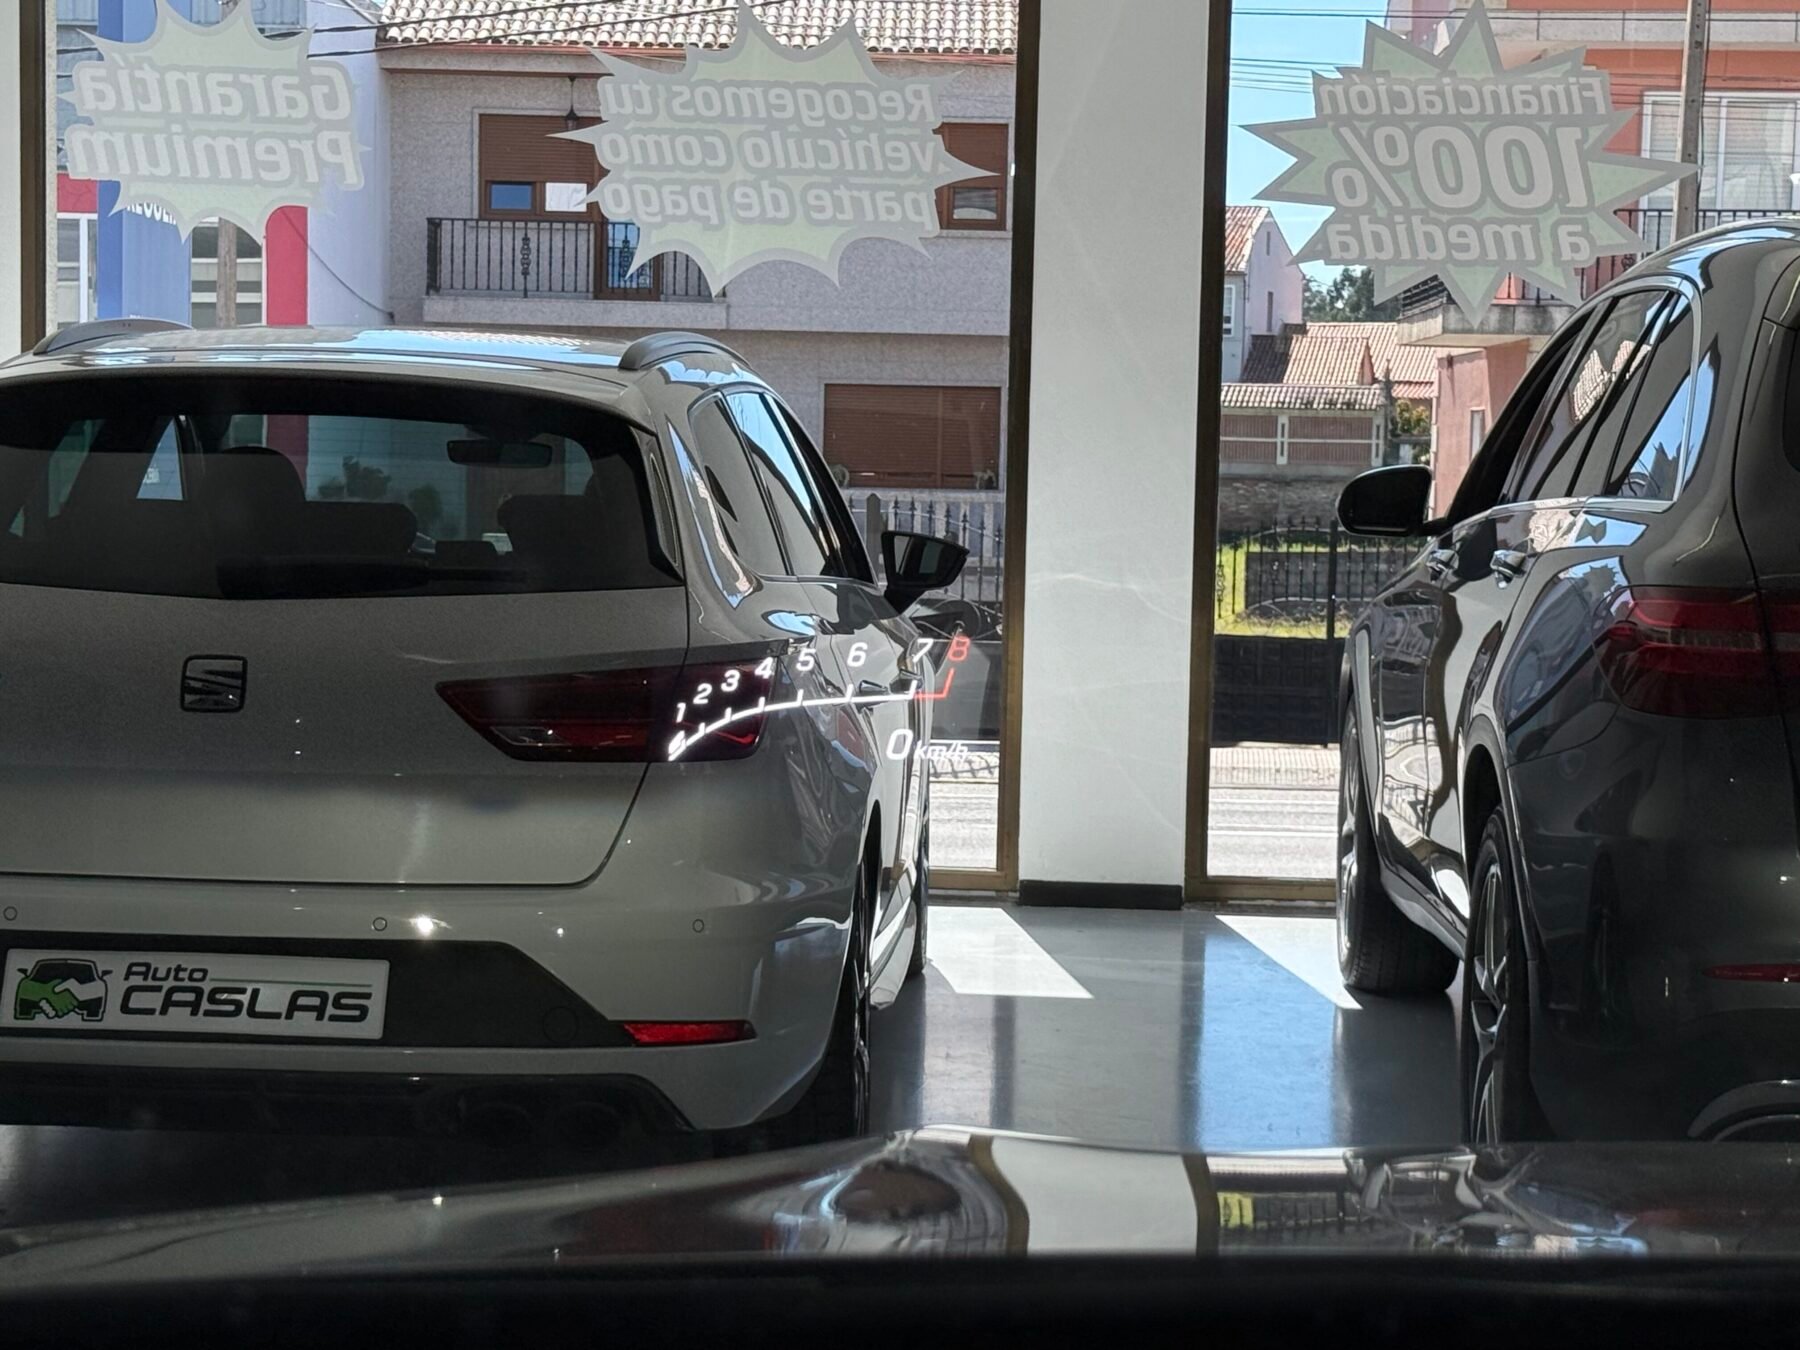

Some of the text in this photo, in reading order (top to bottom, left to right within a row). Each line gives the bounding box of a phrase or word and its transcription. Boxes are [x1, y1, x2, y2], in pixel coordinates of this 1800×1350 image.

[676, 635, 970, 723] 1 2 3 4 5 6 7 8
[885, 729, 913, 760] 0
[123, 961, 208, 982] Auto
[120, 984, 373, 1023] CASLAS
